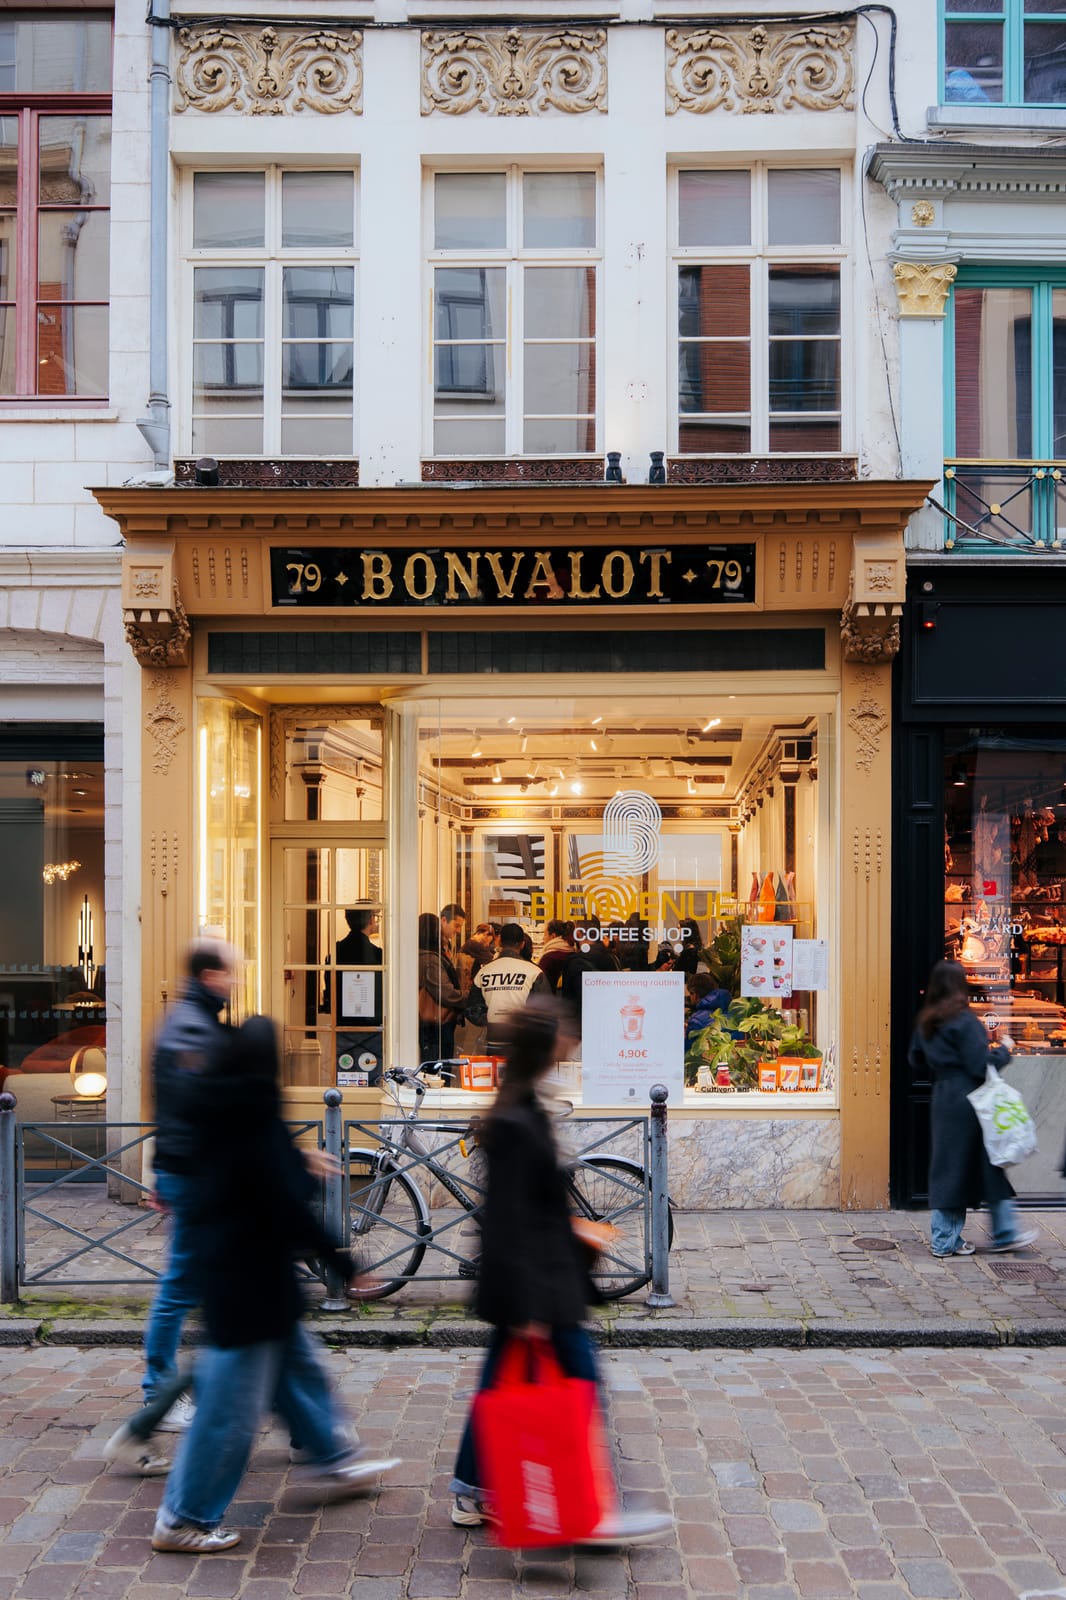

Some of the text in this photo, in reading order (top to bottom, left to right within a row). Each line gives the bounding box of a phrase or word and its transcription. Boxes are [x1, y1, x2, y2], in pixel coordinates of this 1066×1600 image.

[286, 551, 743, 600] 79 BONVALOT 79
[531, 892, 736, 921] BIENVENUE
[573, 927, 692, 942] COFFEE SHOP
[584, 978, 680, 989] Coffee morning routine
[618, 1049, 649, 1059] 4,90€
